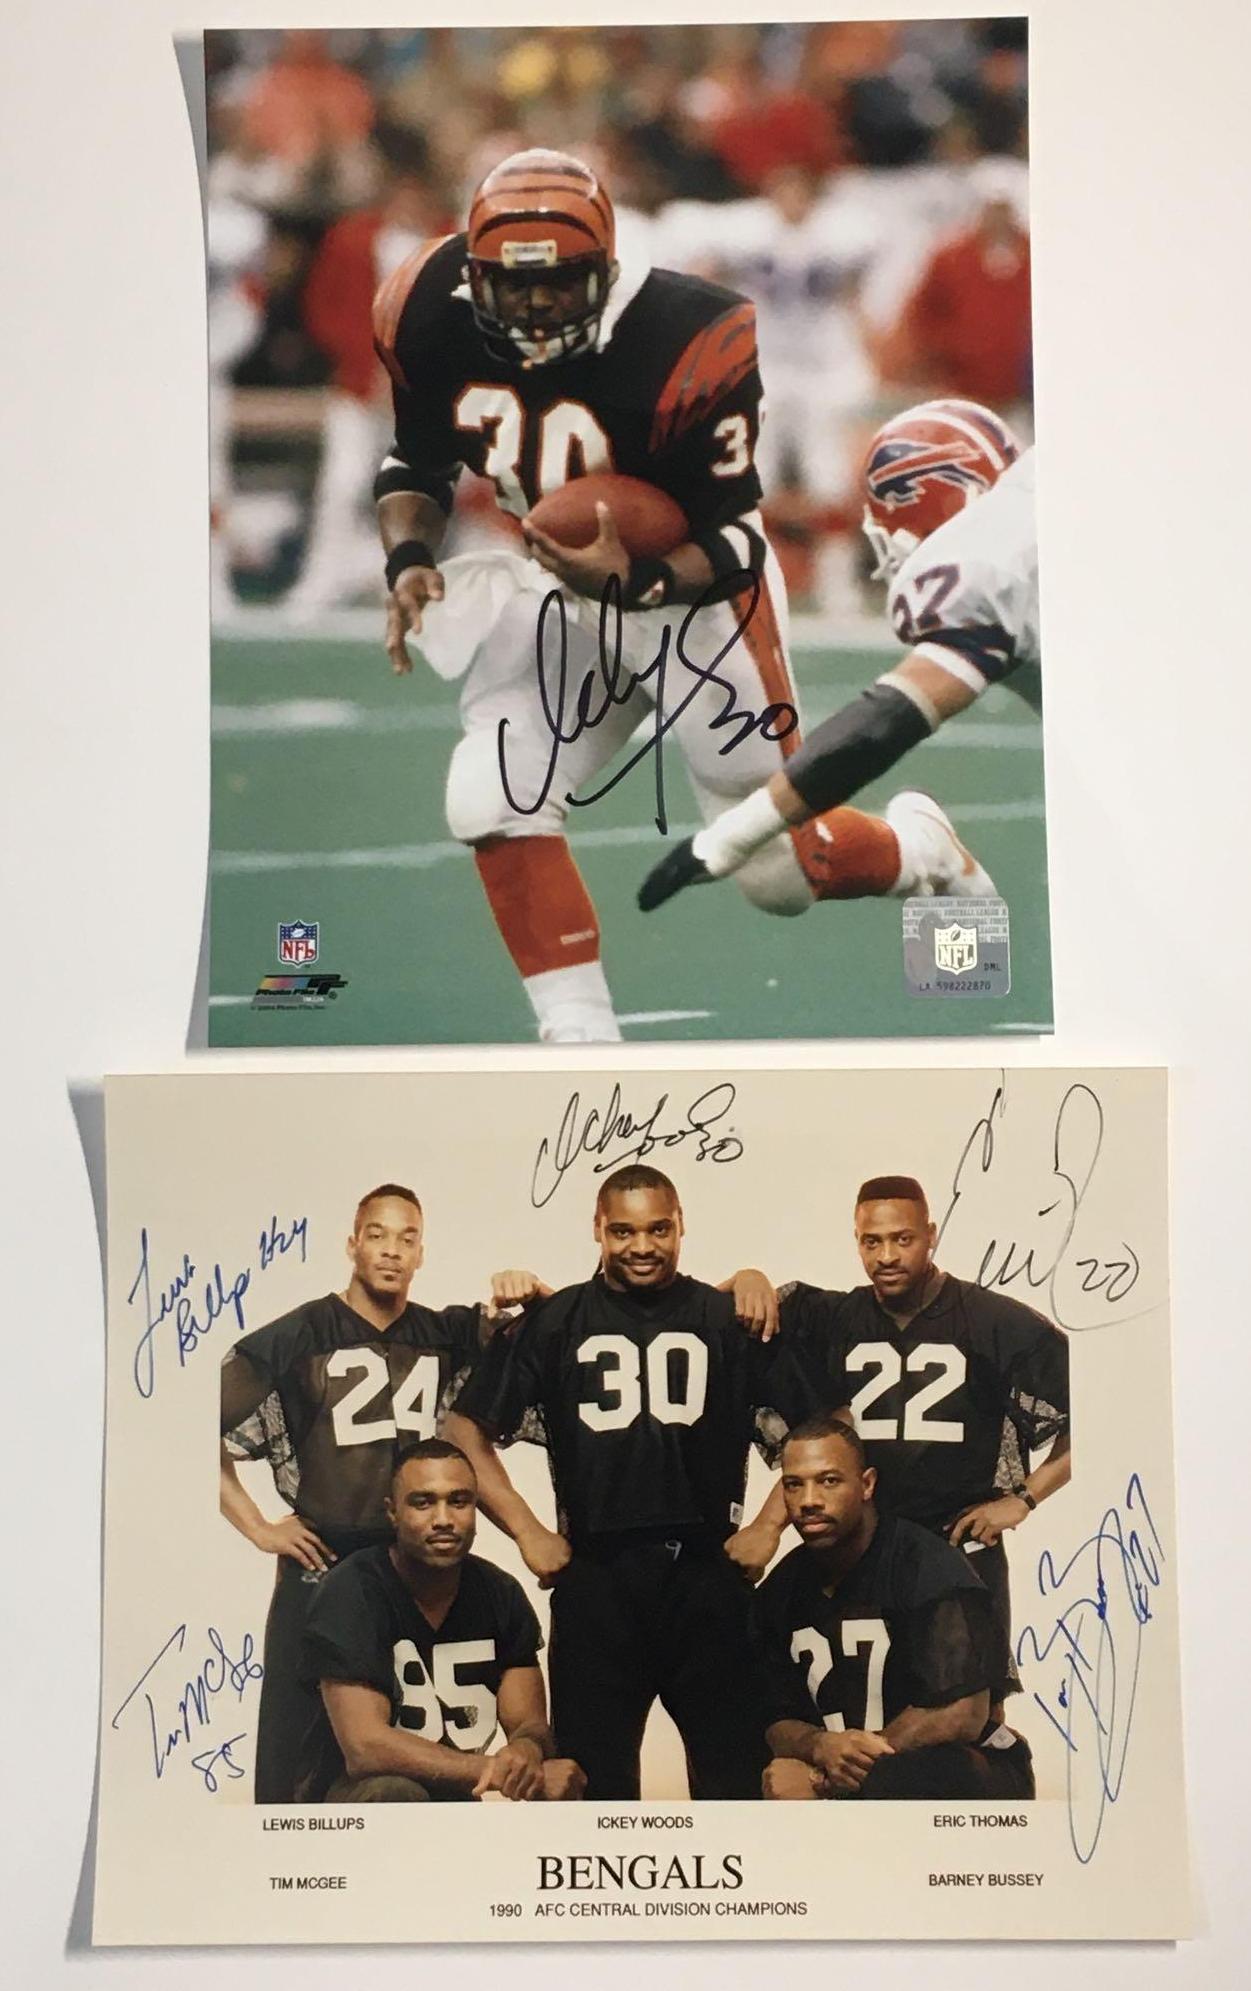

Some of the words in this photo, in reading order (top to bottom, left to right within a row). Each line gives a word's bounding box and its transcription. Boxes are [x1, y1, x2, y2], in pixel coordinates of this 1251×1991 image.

[453, 382, 617, 510] 30
[281, 940, 316, 961] NFL
[938, 944, 975, 968] NFL
[576, 1331, 708, 1432] 30
[845, 1341, 967, 1443] 22
[326, 1347, 440, 1447] 24
[790, 1618, 892, 1733] 27
[393, 1639, 497, 1751] 85
[262, 1818, 306, 1831] LEWIS
[308, 1817, 365, 1830] BILLUPS
[597, 1816, 638, 1829] ICKEY
[641, 1816, 694, 1829] WOODS
[933, 1815, 966, 1827] ERIC
[969, 1814, 1028, 1827] THOMAS
[269, 1877, 293, 1889] TIM
[296, 1876, 347, 1889] MCGEE
[536, 1854, 744, 1890] BENGALS
[928, 1873, 985, 1886] BARNEY
[988, 1873, 1044, 1886] BUSSEY
[489, 1903, 522, 1917] 1990
[534, 1903, 566, 1917] AFC
[569, 1902, 641, 1917] CENTRAL
[644, 1901, 711, 1916] DIVISION
[715, 1901, 808, 1916] CHAMPIONS
